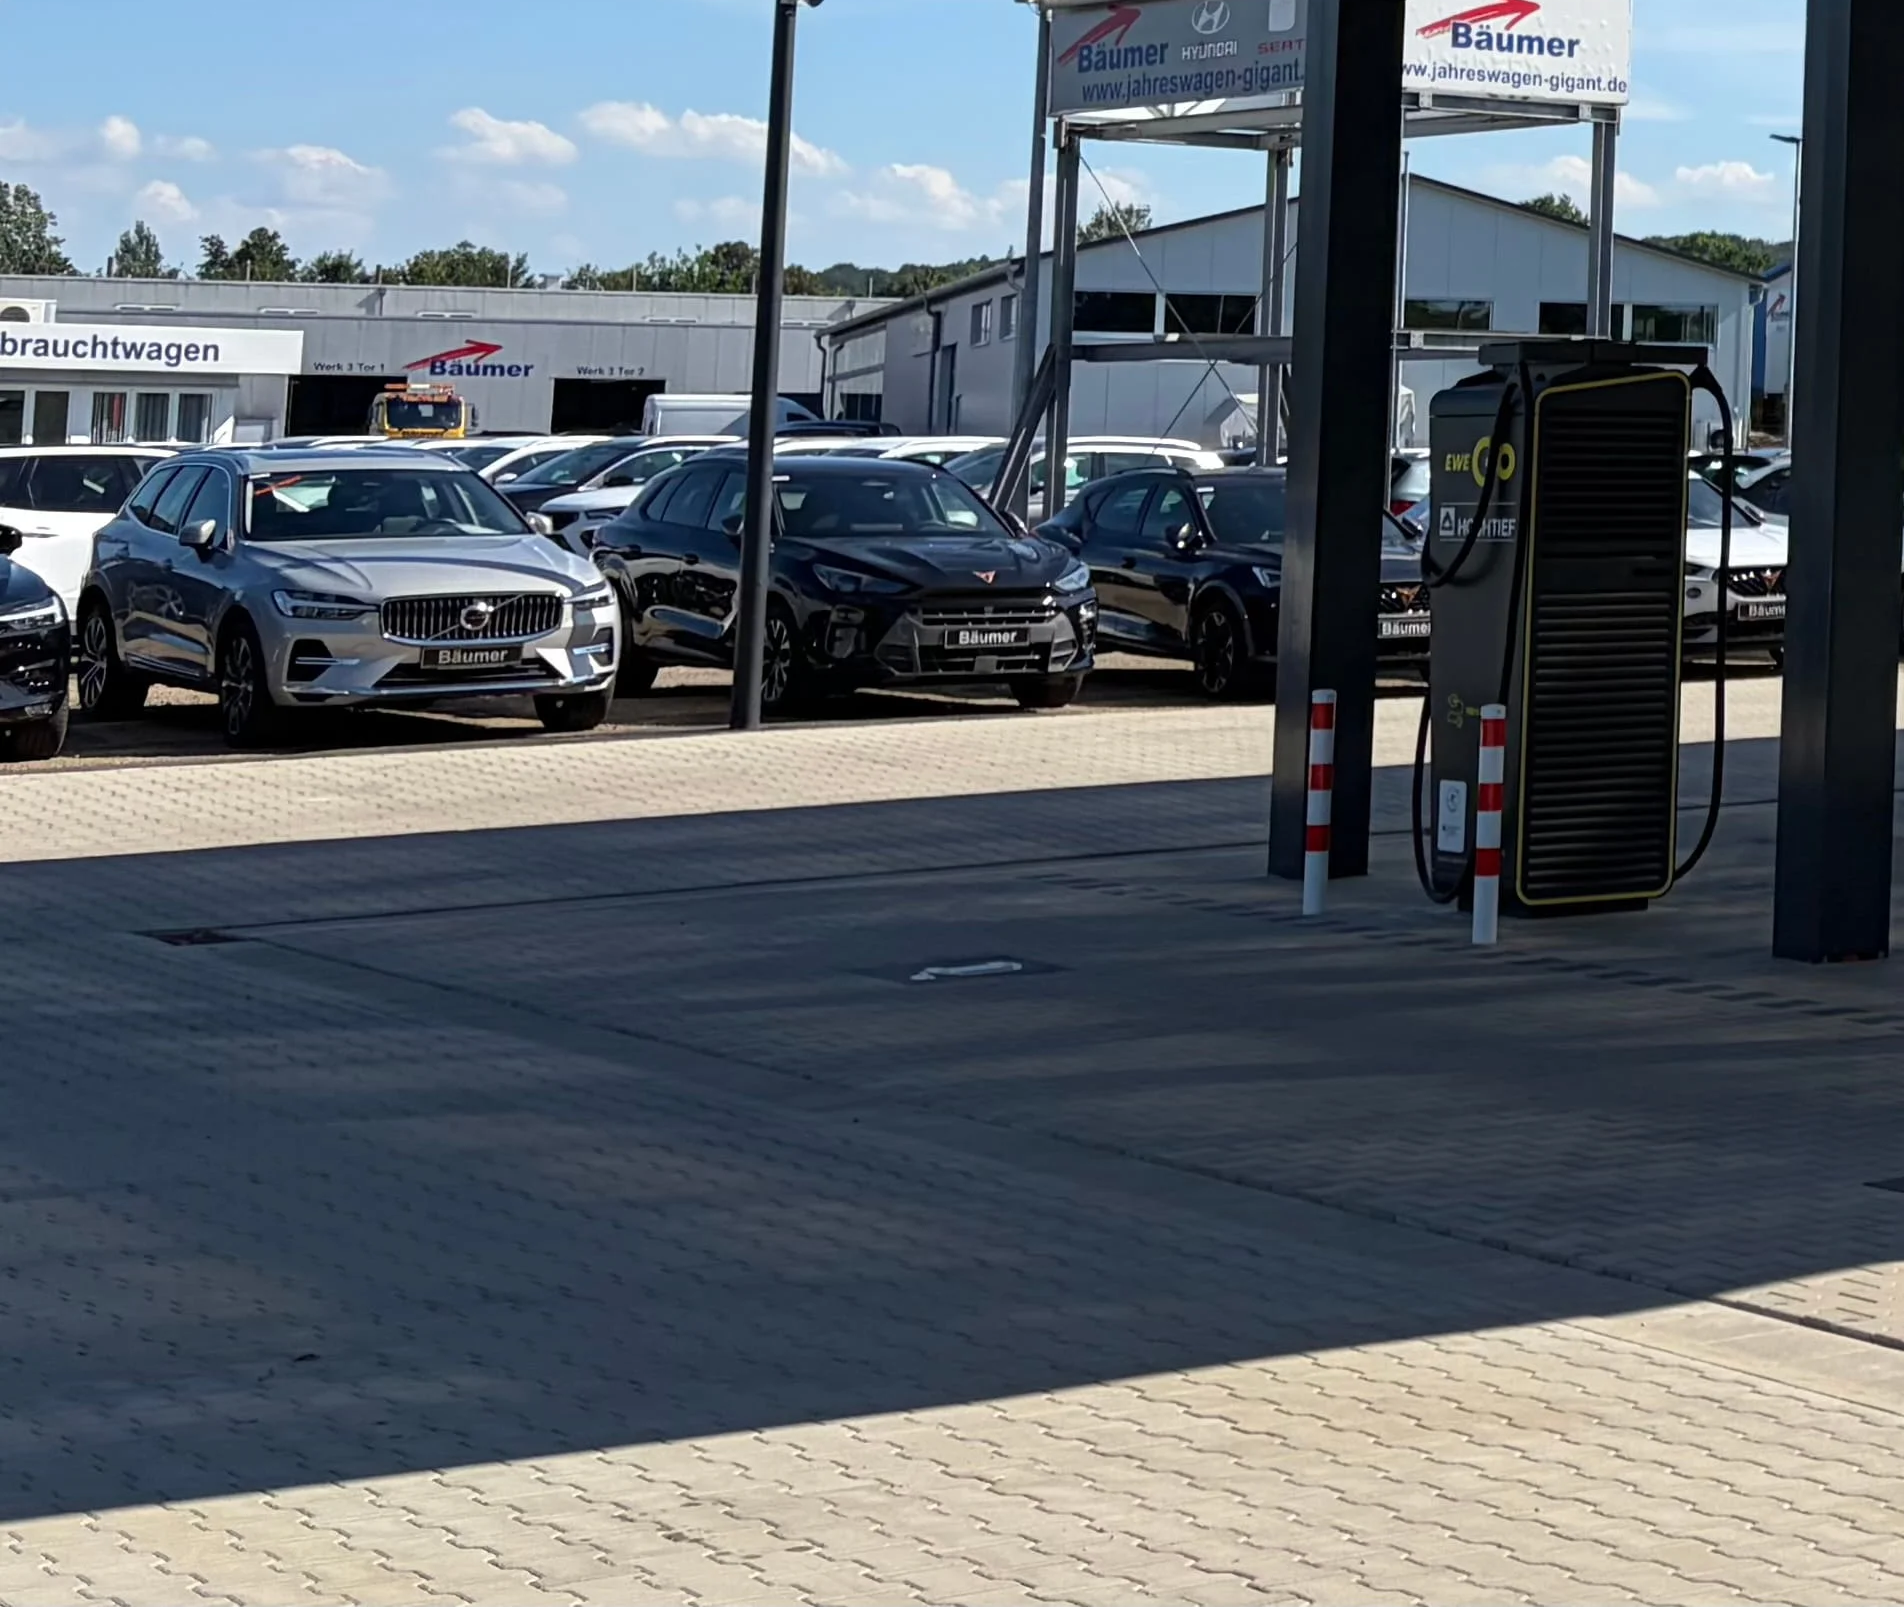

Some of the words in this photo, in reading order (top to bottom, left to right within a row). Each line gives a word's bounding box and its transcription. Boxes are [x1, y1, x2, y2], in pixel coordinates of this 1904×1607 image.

[1257, 38, 1306, 54] SEAT
[1451, 22, 1581, 58] Bäumer
[1078, 41, 1169, 73] Bäumer
[1182, 40, 1237, 61] HYUNDAI
[0, 331, 220, 367] brauchtwagen
[313, 362, 344, 372] Werk
[357, 363, 376, 373] Tor
[429, 360, 534, 378] Bäumer
[1444, 453, 1471, 471] EWE
[1457, 518, 1517, 537] HOHTIEF
[959, 629, 1017, 645] Bäumer
[438, 649, 508, 664] Bäumer
